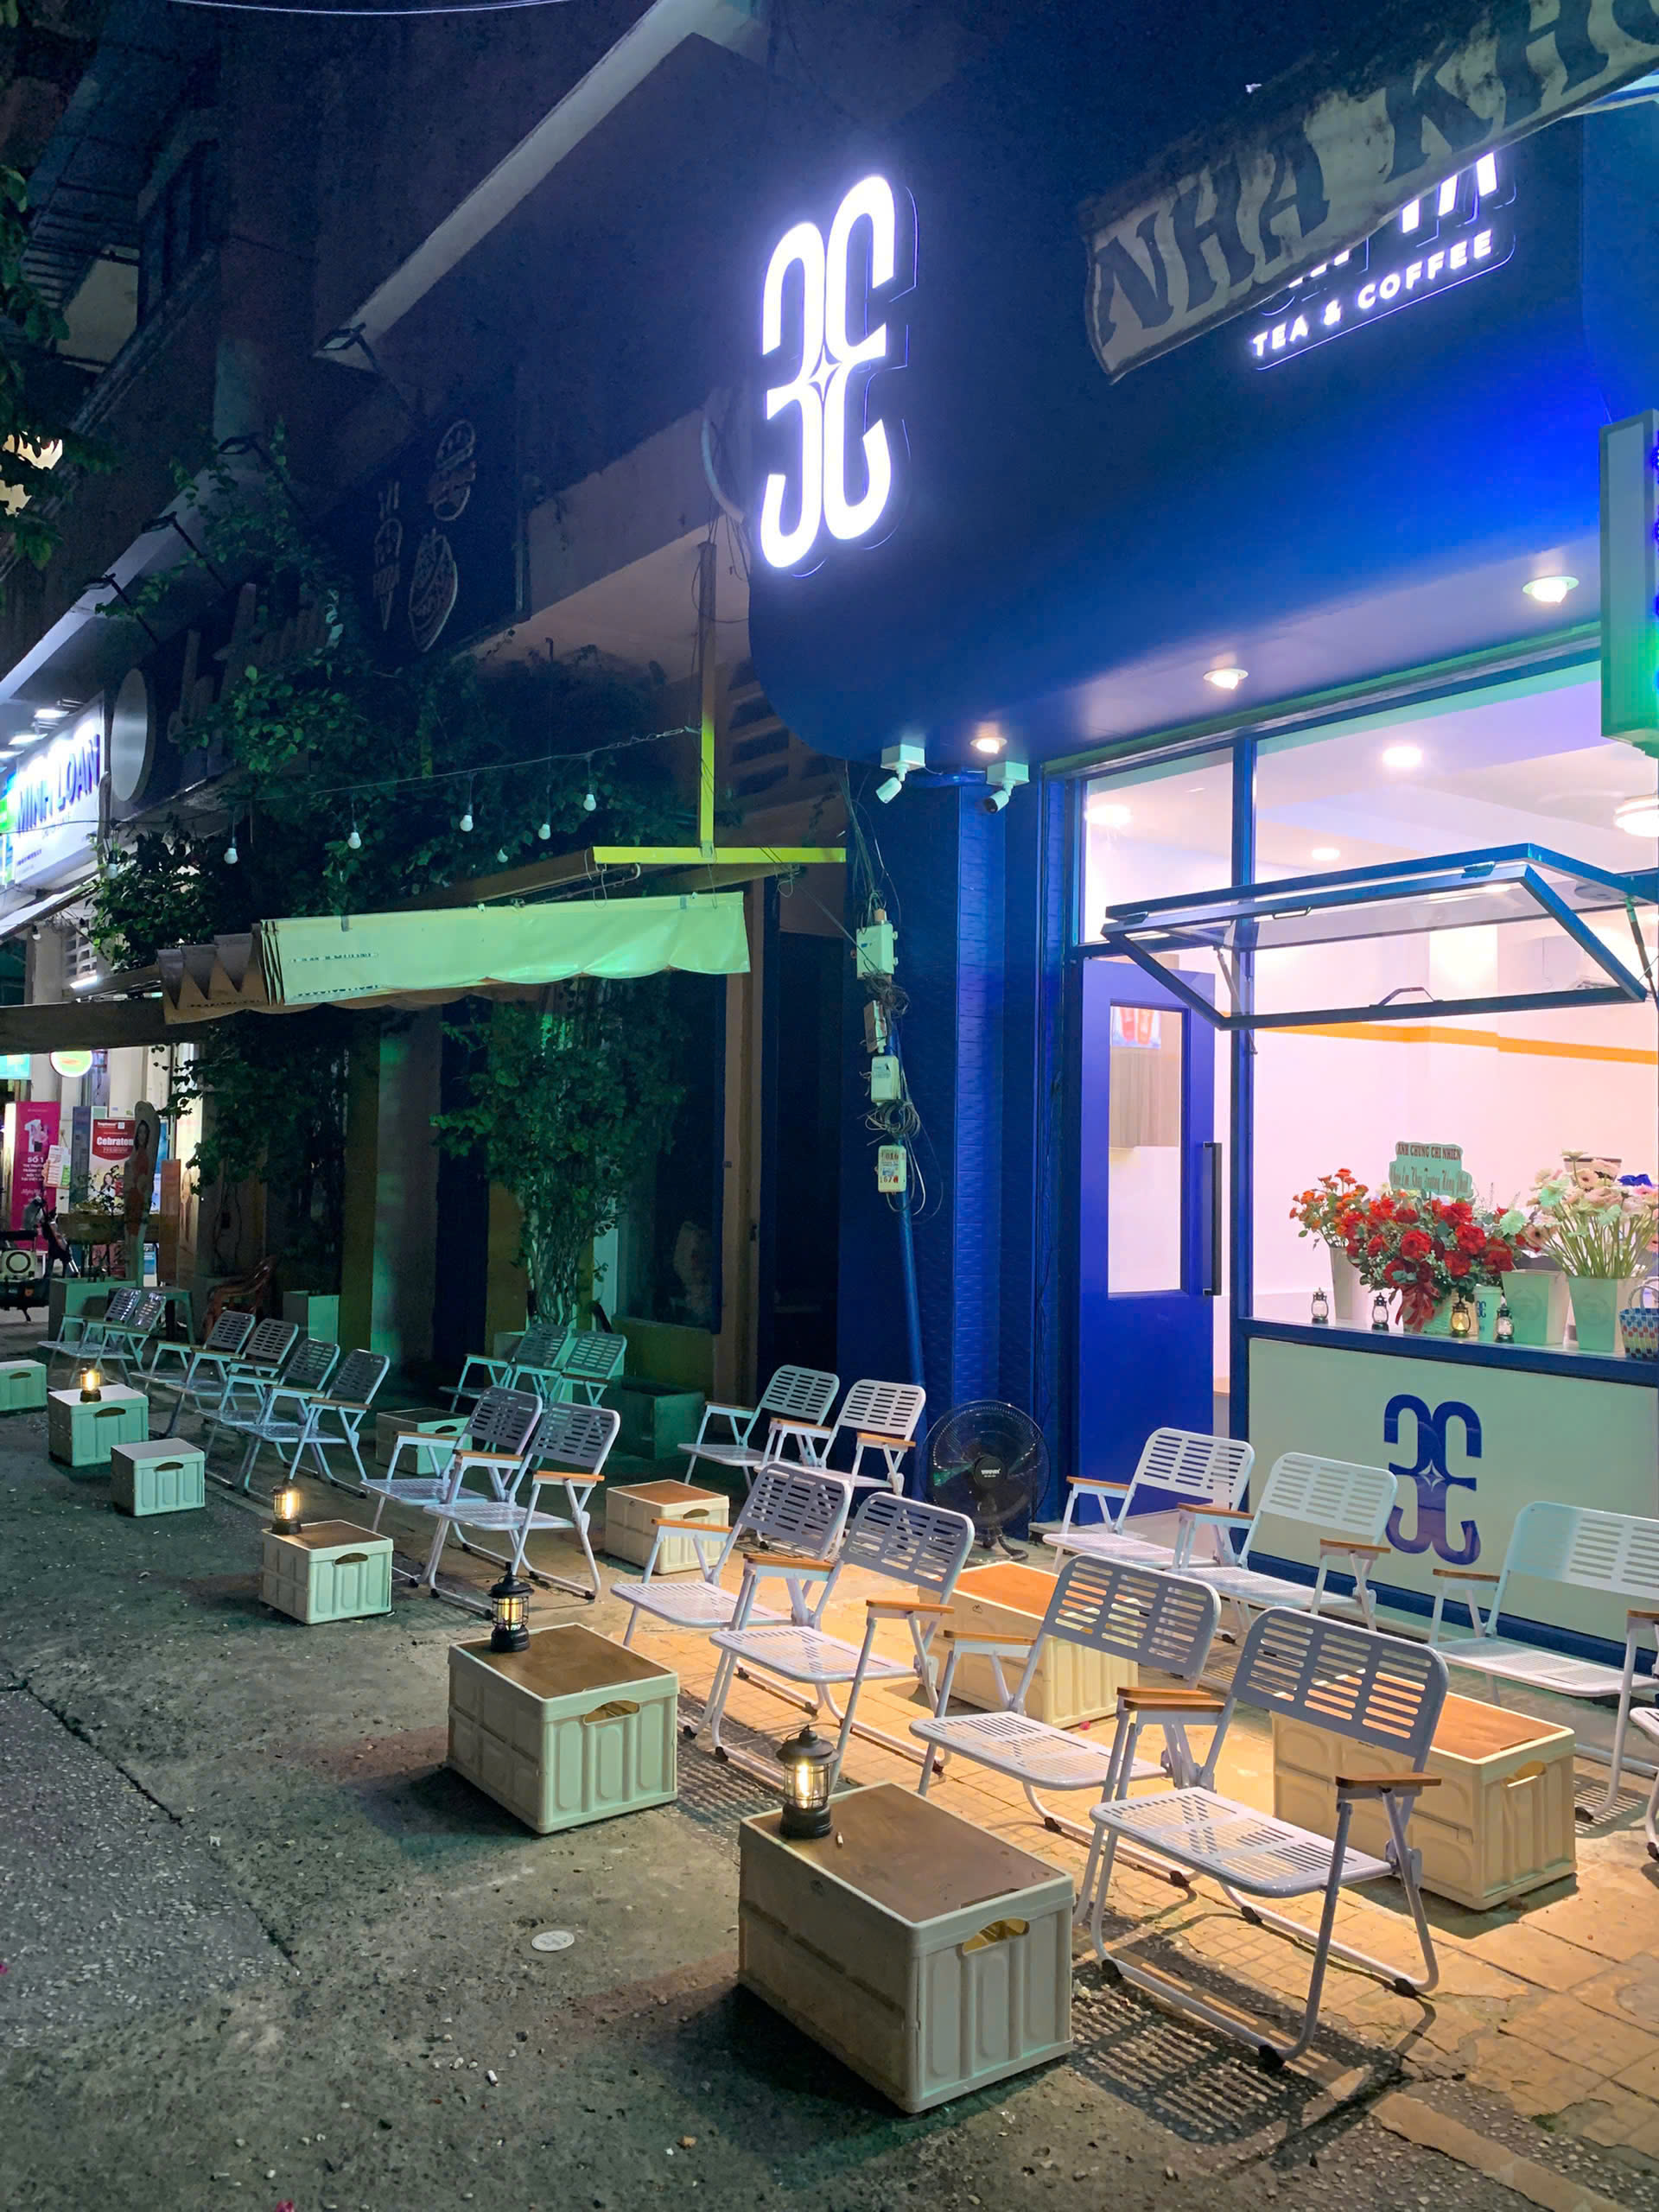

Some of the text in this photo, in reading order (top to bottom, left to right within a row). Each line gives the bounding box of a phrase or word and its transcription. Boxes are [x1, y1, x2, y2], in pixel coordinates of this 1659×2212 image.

[1252, 228, 1492, 357] TEA & COFFEE
